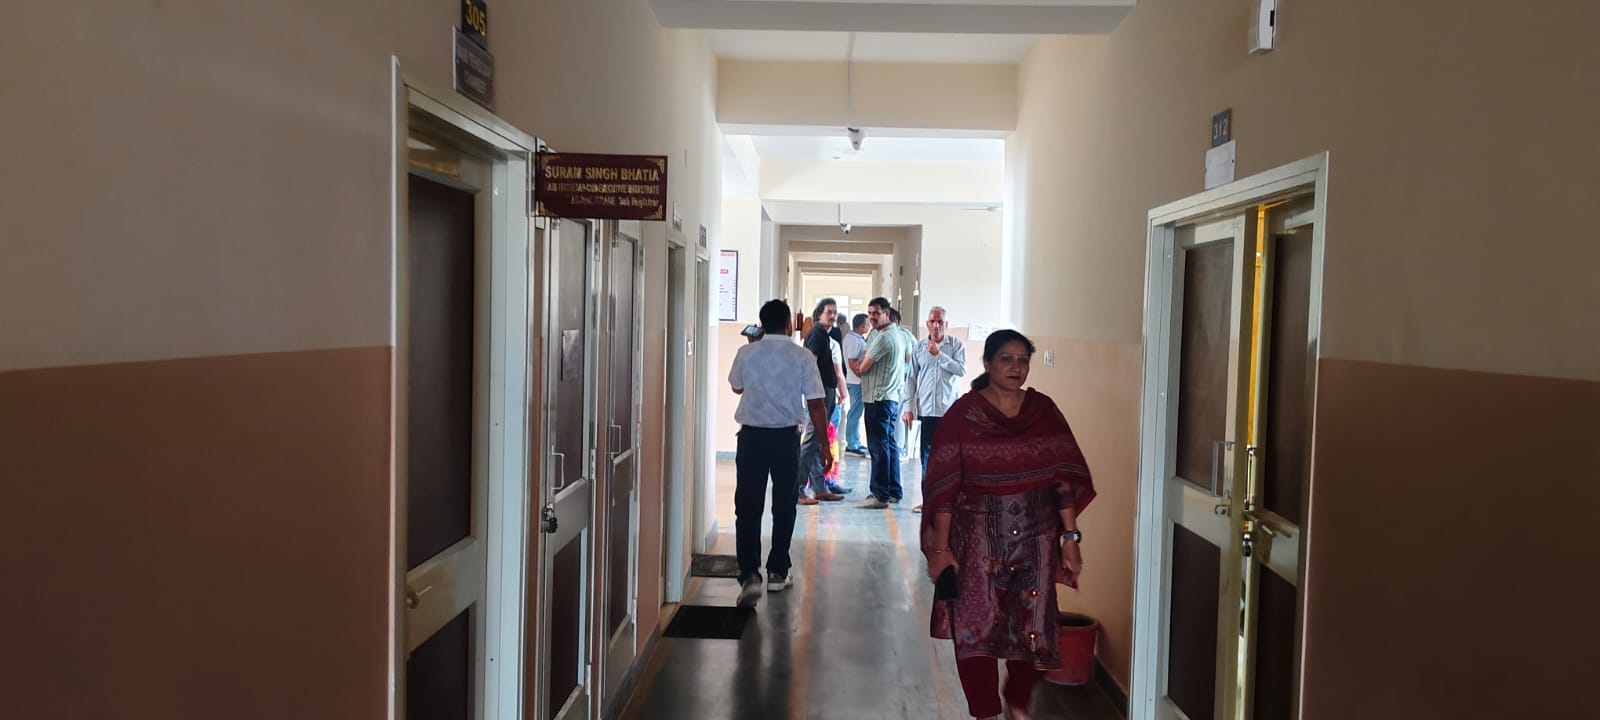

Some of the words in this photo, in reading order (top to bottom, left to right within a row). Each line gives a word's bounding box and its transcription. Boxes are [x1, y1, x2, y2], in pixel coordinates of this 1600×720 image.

[466, 0, 486, 36] 305
[545, 166, 582, 180] SURAM
[585, 167, 618, 180] SINGH
[621, 168, 659, 182] BHATIA
